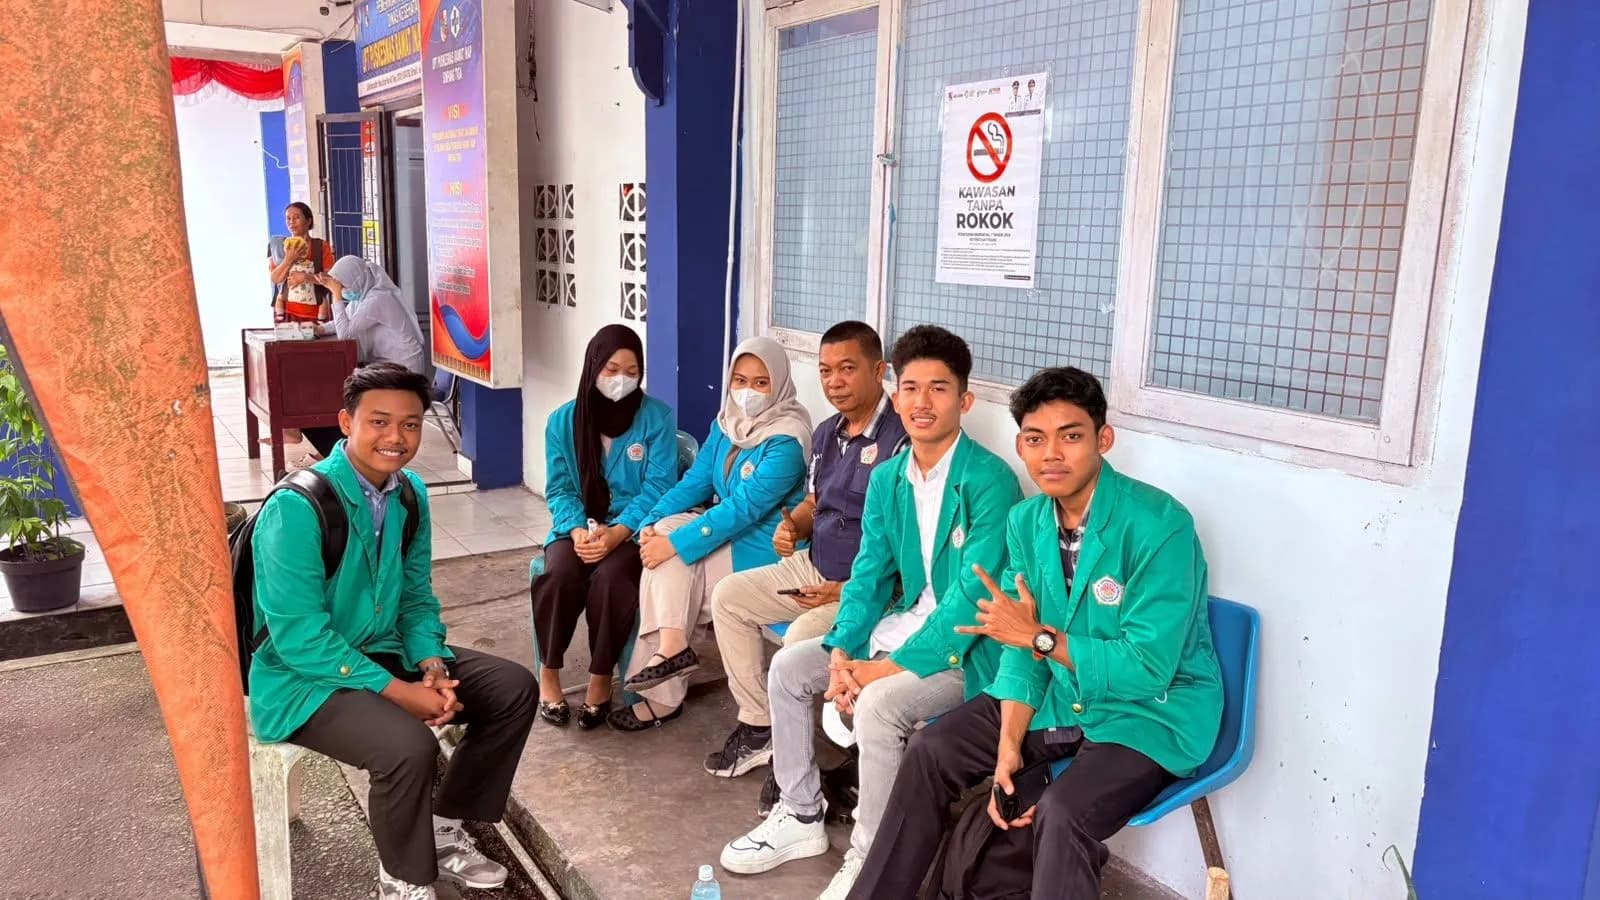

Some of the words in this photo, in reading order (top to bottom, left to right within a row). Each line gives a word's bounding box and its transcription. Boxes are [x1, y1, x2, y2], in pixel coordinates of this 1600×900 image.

[447, 103, 460, 120] VISI
[958, 185, 1016, 199] KAWASAN
[967, 199, 1004, 211] TANPA
[956, 212, 1014, 229] ROKOK
